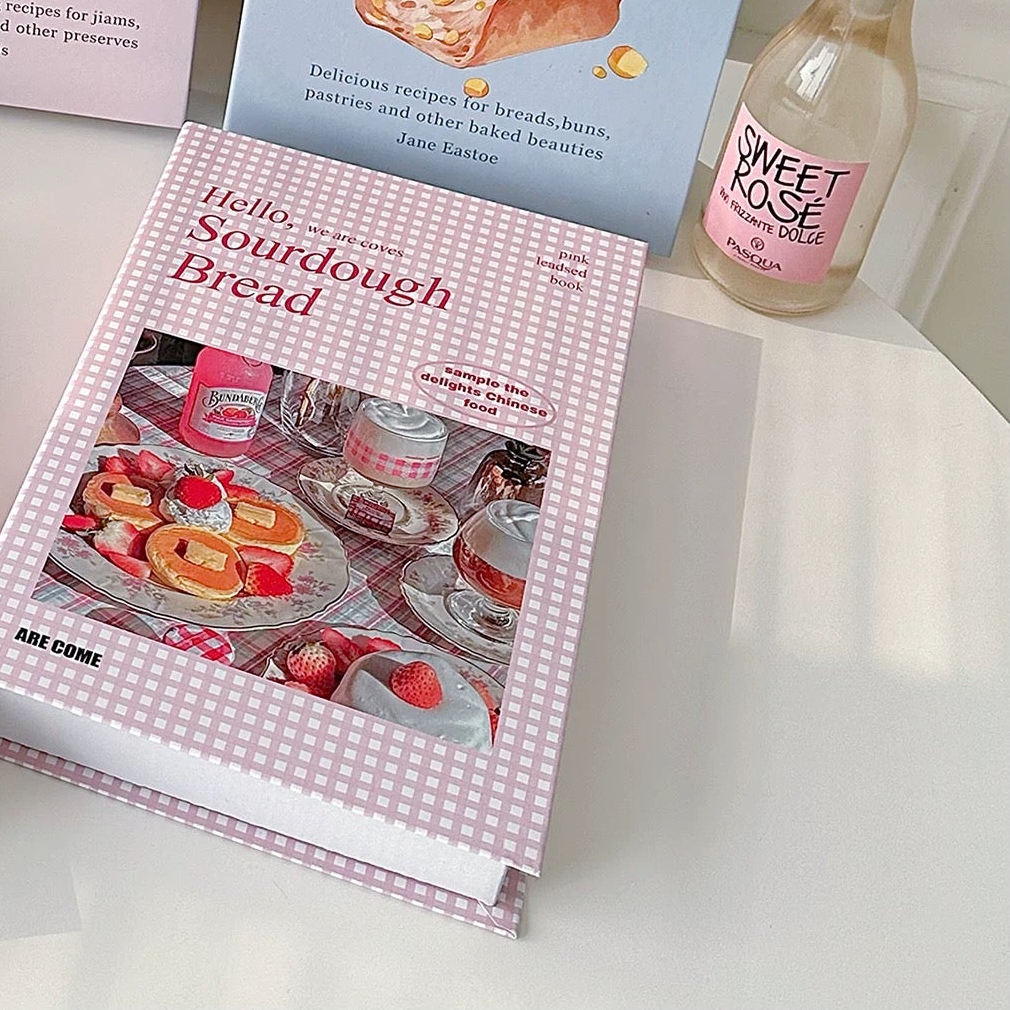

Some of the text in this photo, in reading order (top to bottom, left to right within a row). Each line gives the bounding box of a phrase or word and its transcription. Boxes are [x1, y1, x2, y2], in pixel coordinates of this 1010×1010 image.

[5, 0, 62, 20] recipes
[65, 6, 90, 22] for
[89, 10, 141, 31] jiams,
[15, 22, 59, 40] other
[63, 30, 139, 50] preserves
[309, 63, 390, 93] Delicious
[394, 82, 458, 108] recipes
[462, 95, 490, 114] for
[304, 86, 604, 162] pastries and other baked beauties
[396, 131, 500, 166] Jane Eastoe
[730, 124, 851, 230] SWEET ROSÉ
[201, 186, 405, 258] Hello, we are coves
[778, 223, 826, 246] DOLCE
[186, 213, 454, 312] Sourdough
[536, 256, 588, 279] leadsed
[558, 250, 590, 265] pink
[726, 236, 783, 273] PASQUA
[167, 250, 323, 317] Bread
[549, 274, 584, 293] book
[420, 372, 548, 418] delights Chinese
[444, 366, 530, 398] sample the
[463, 398, 498, 416] food
[14, 627, 103, 668] ARE COME
